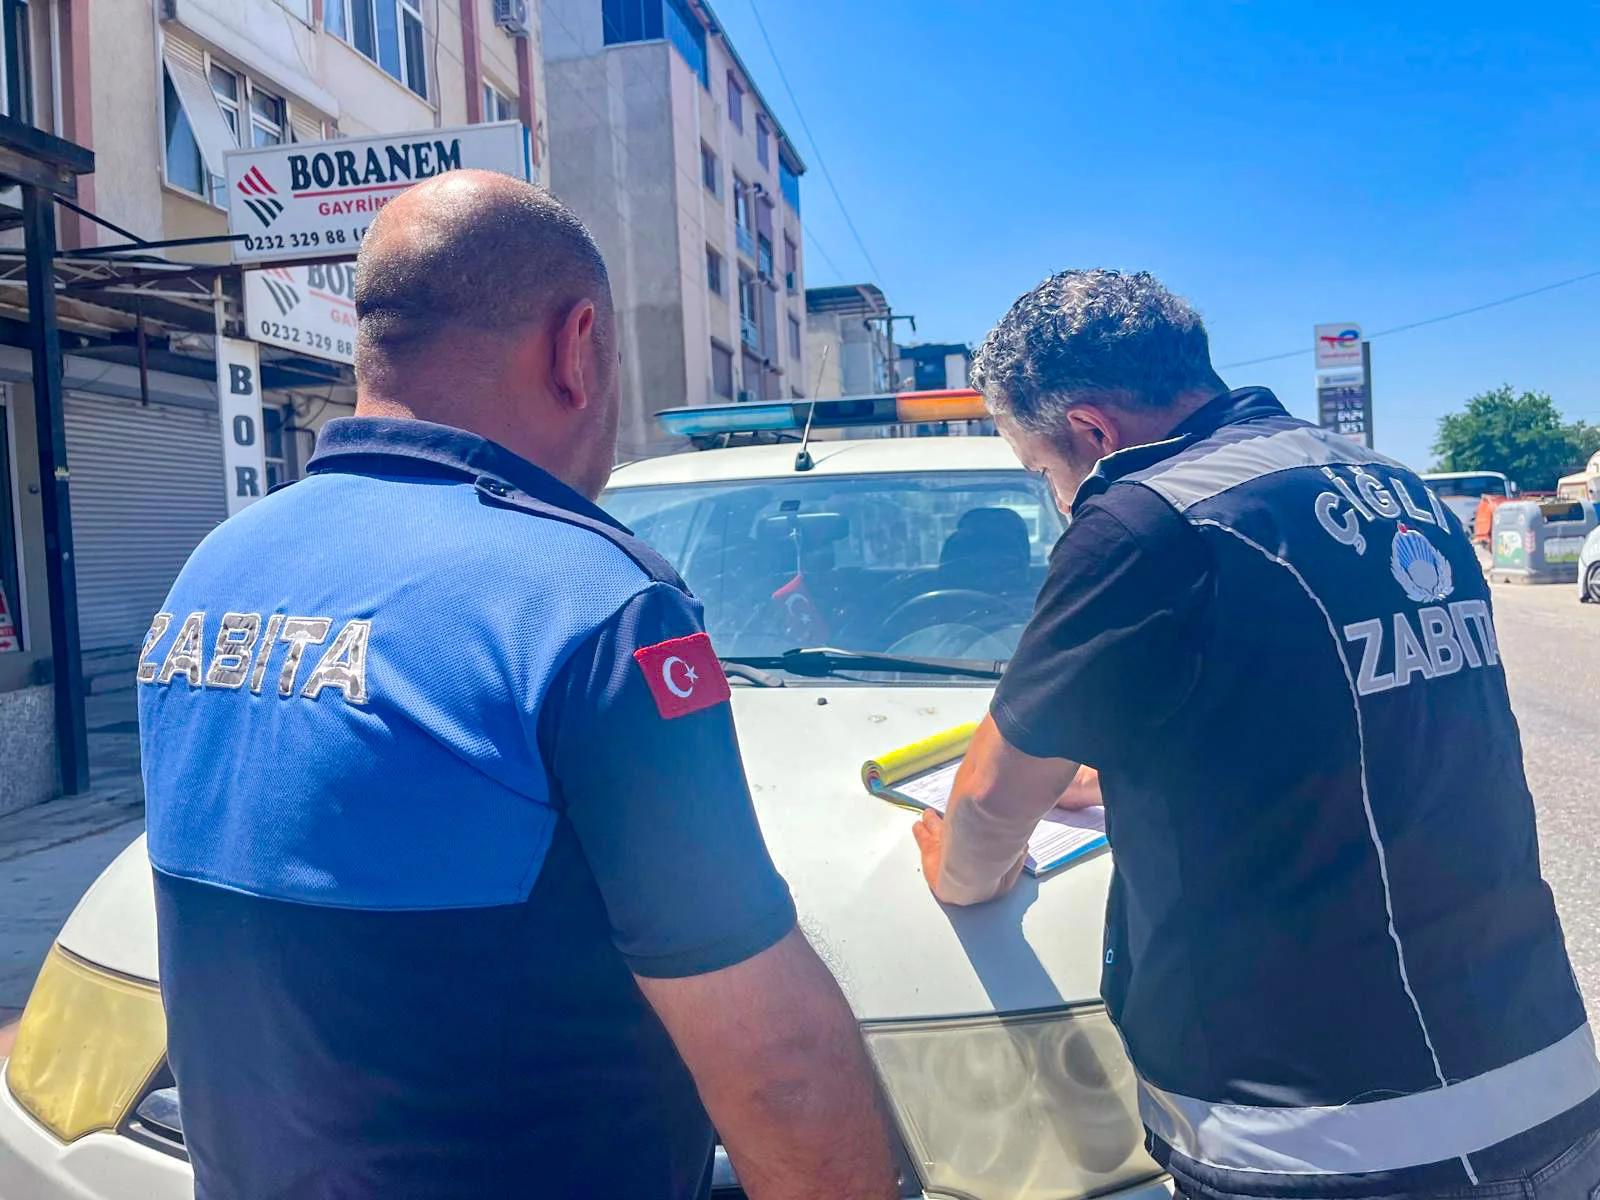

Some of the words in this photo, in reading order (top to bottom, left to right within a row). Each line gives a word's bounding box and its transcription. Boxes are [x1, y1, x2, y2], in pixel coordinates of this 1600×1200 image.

[287, 138, 462, 191] BORANEM
[318, 194, 393, 216] GAYRİM
[244, 234, 285, 251] 0232
[290, 232, 319, 247] 329
[325, 229, 346, 244] 88
[261, 320, 300, 342] 0232
[306, 331, 332, 351] 329
[337, 339, 352, 356] 88
